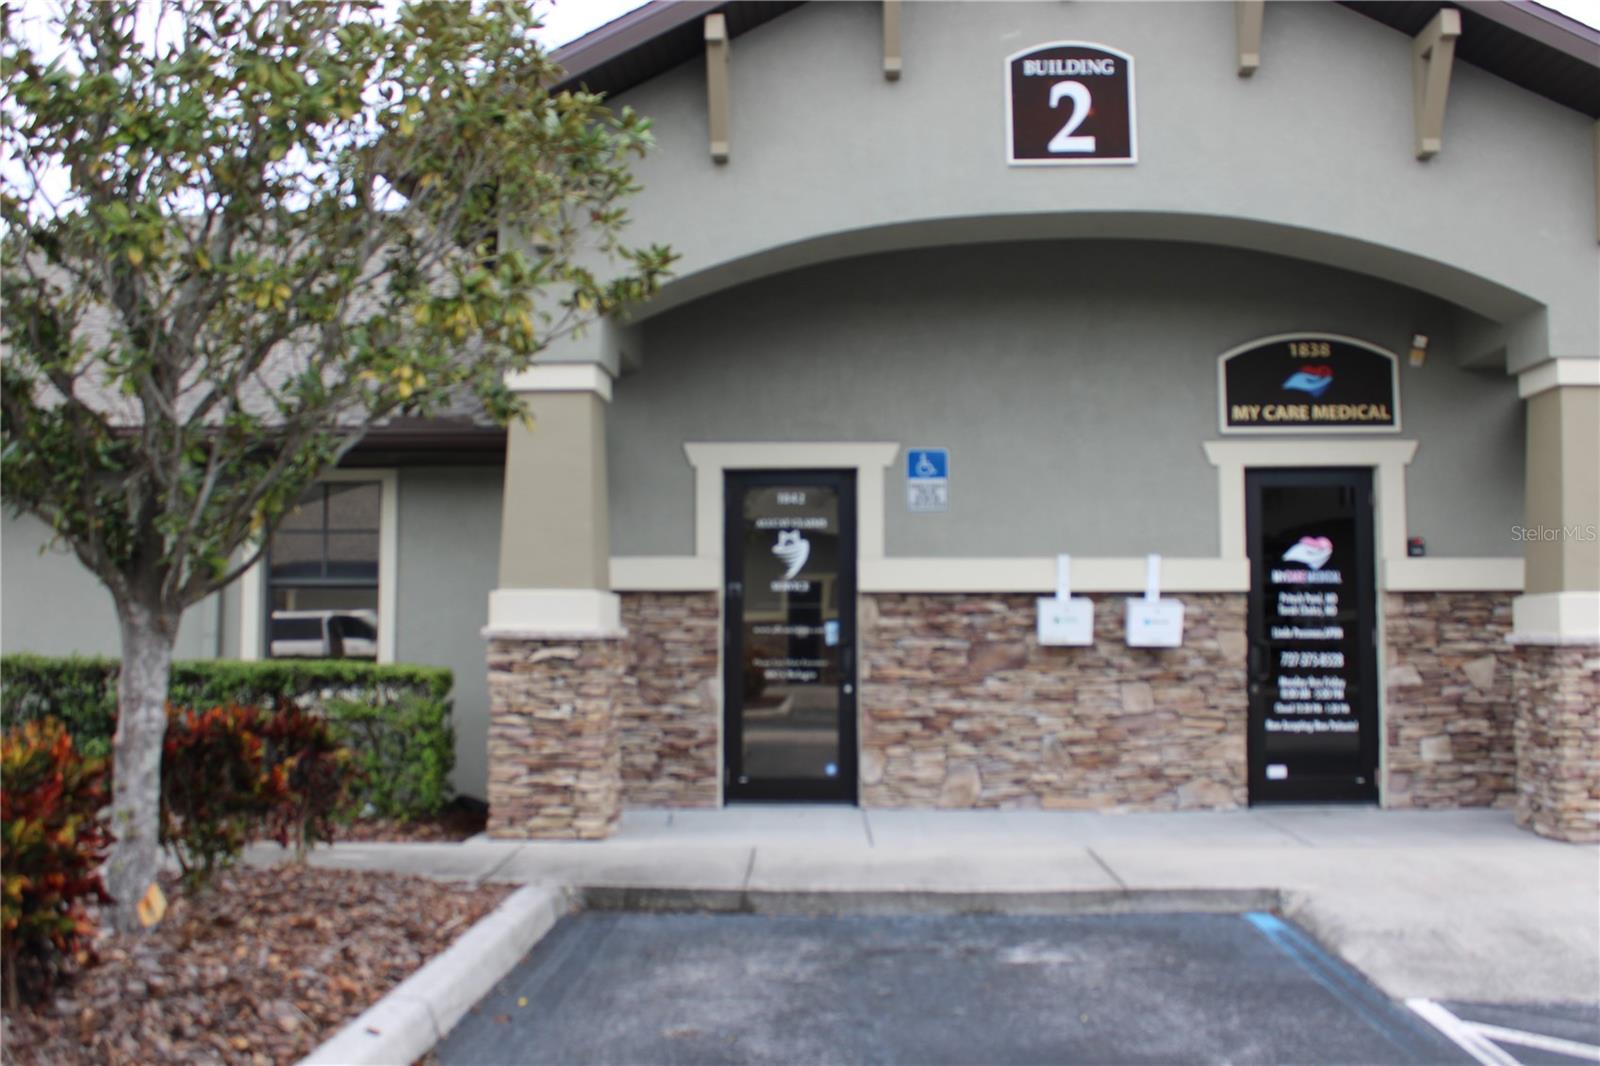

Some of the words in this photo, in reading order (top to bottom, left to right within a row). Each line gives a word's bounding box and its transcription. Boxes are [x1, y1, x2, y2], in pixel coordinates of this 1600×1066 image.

[1023, 59, 1115, 76] BUILDING
[1047, 80, 1096, 153] 2
[1290, 342, 1331, 358] 1838
[1231, 404, 1261, 421] MY
[1262, 404, 1309, 420] CARE
[1312, 404, 1391, 420] MEDICAL
